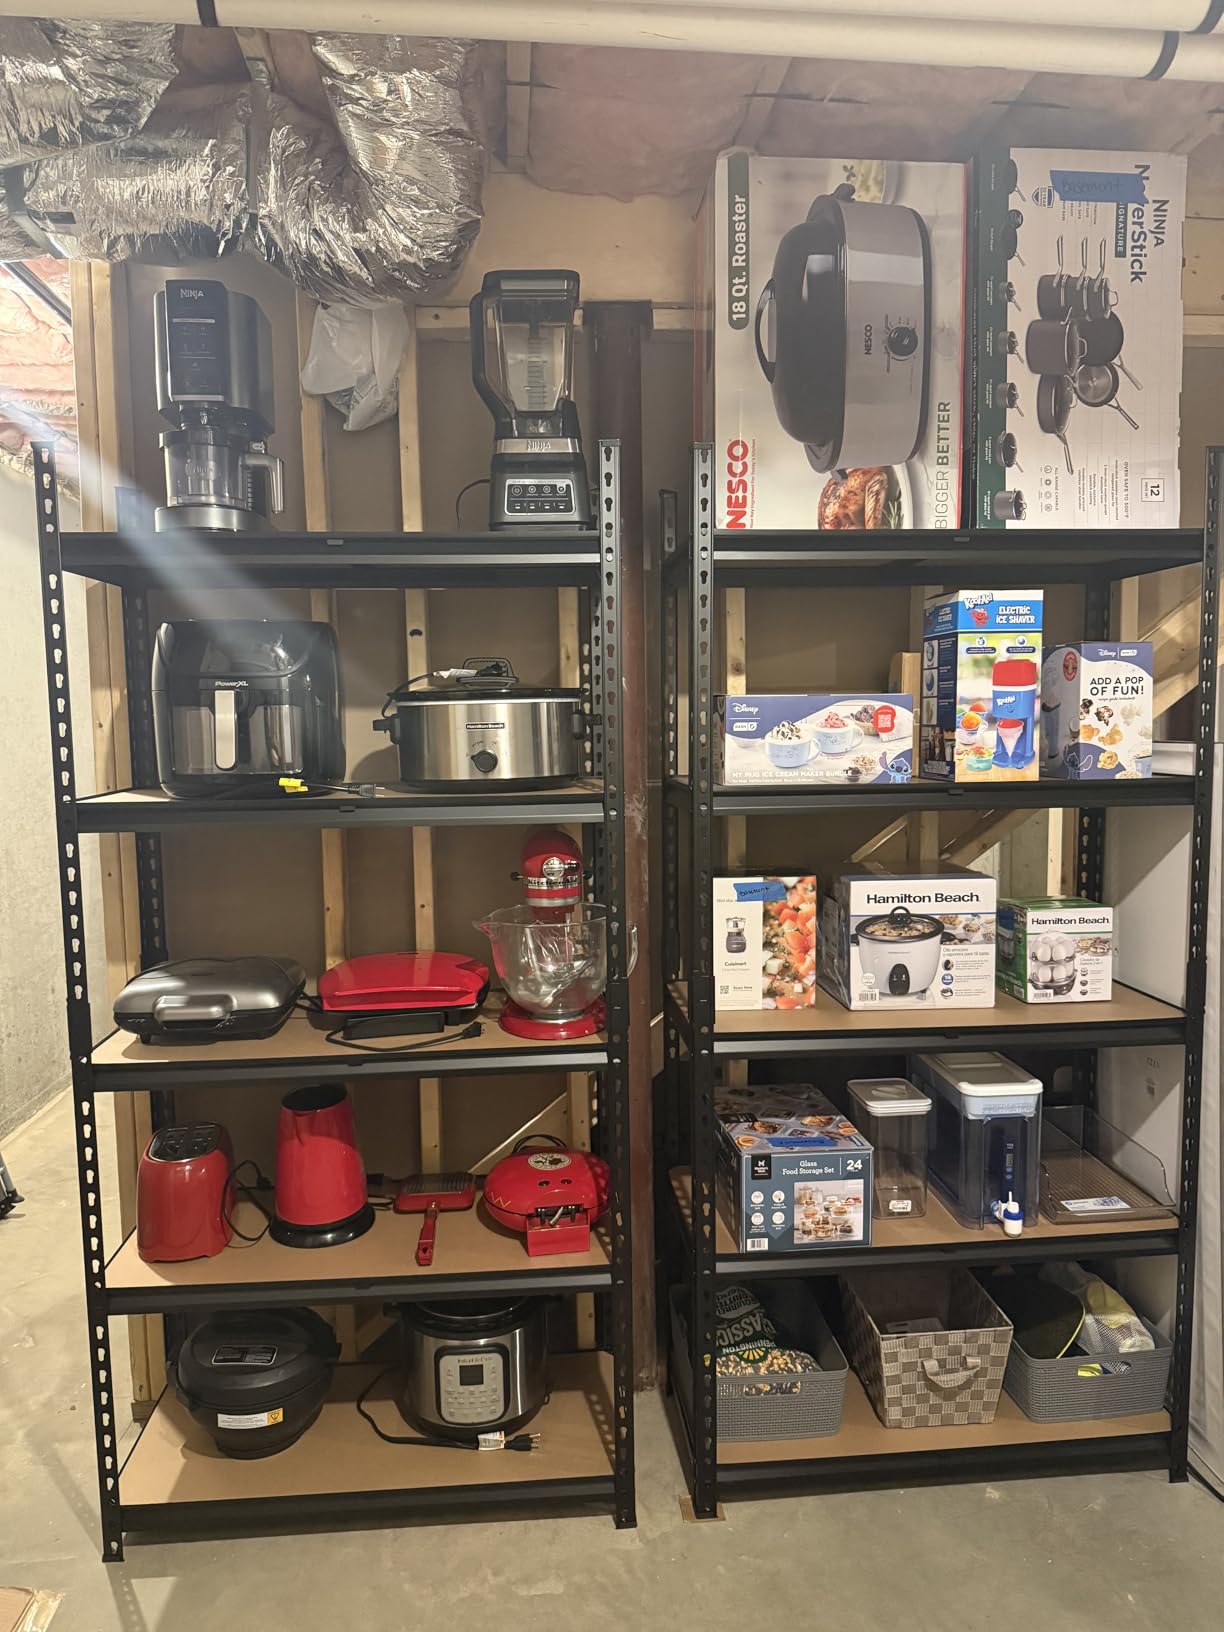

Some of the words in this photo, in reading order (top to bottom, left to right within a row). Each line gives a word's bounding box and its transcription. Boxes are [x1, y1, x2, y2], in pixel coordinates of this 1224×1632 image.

[1116, 200, 1125, 252] IGNATURE
[1149, 199, 1170, 248] NINJA
[732, 194, 748, 267] Roaster
[732, 271, 748, 297] Qt.
[180, 288, 204, 299] NINJA
[732, 301, 747, 321] 18
[864, 323, 873, 356] NESCO
[936, 401, 951, 466] BETTER
[527, 440, 551, 452] NINJA
[726, 438, 749, 529] NESCO
[1150, 483, 1160, 497] 12
[935, 470, 950, 529] BIGGER
[1123, 493, 1129, 502] TO
[1008, 615, 1036, 624] SHAVER
[1097, 648, 1117, 658] Disney
[1090, 677, 1112, 685] ADD
[1114, 677, 1122, 685] A
[1124, 676, 1144, 685] POP
[1090, 687, 1107, 696] OF
[1112, 686, 1144, 695] FUN!
[731, 702, 759, 715] Disney
[866, 892, 932, 904] Hamilton
[934, 892, 980, 903] Beach
[1031, 917, 1077, 926] Hamilton
[1078, 916, 1110, 925] Beach
[799, 1167, 823, 1175] Storage
[846, 1159, 863, 1170] 24
[722, 1339, 776, 1354] PENNINGTON
